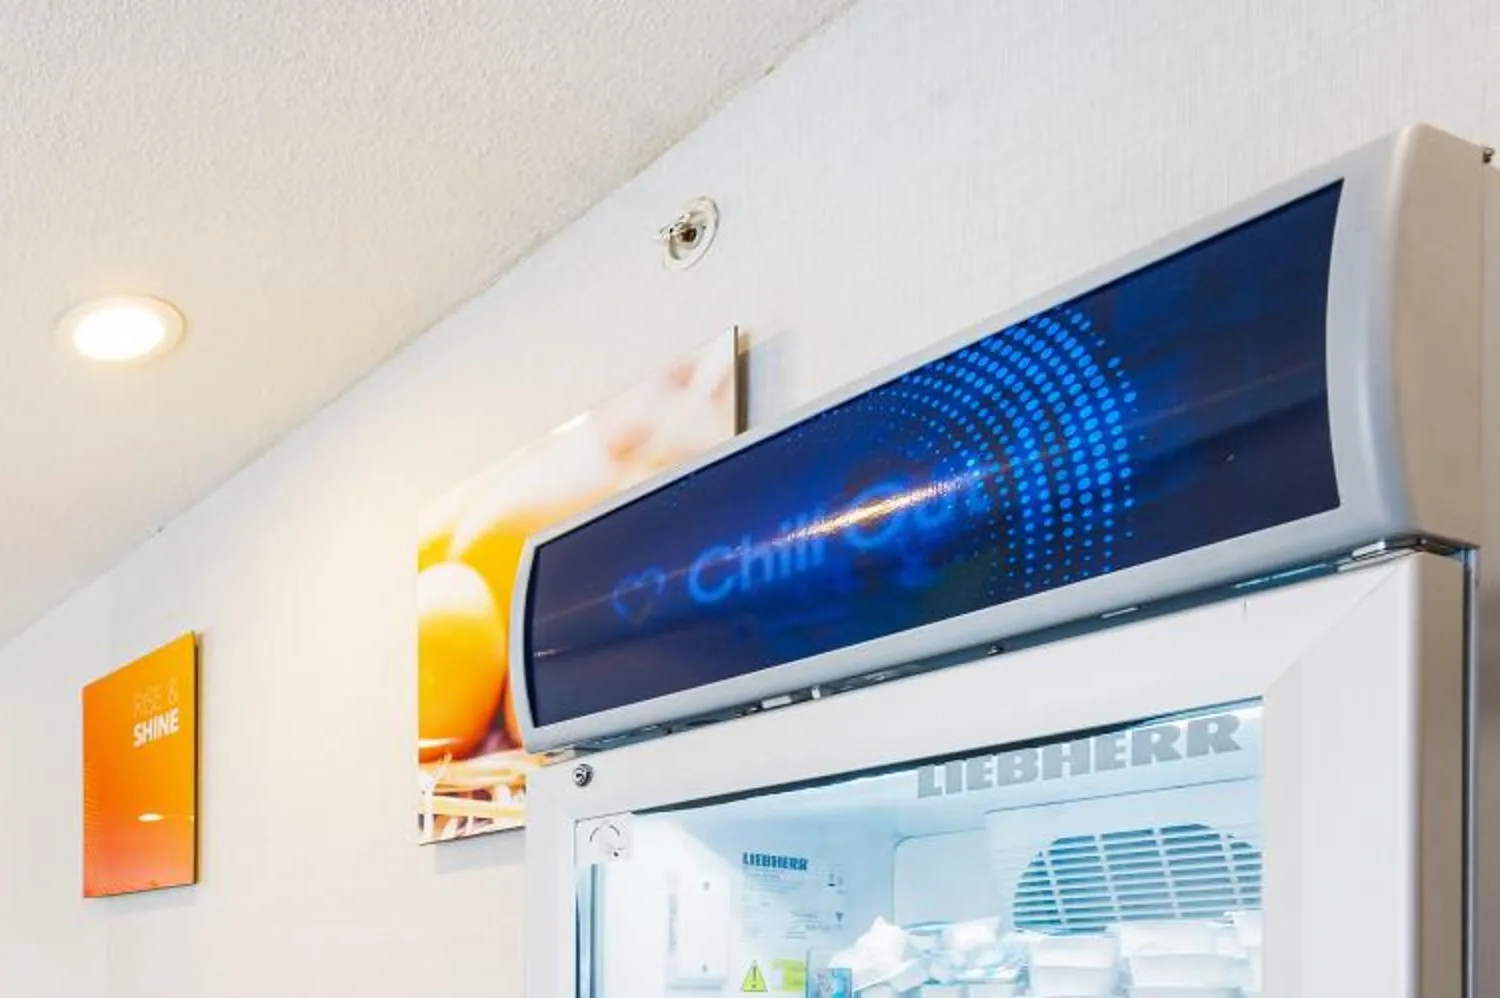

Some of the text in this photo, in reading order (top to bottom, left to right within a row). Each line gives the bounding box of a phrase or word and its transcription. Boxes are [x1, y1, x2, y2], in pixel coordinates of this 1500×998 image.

[133, 708, 180, 748] SHINE
[917, 713, 1243, 799] LIEBHERR
[742, 852, 809, 872] LIEBHERR
